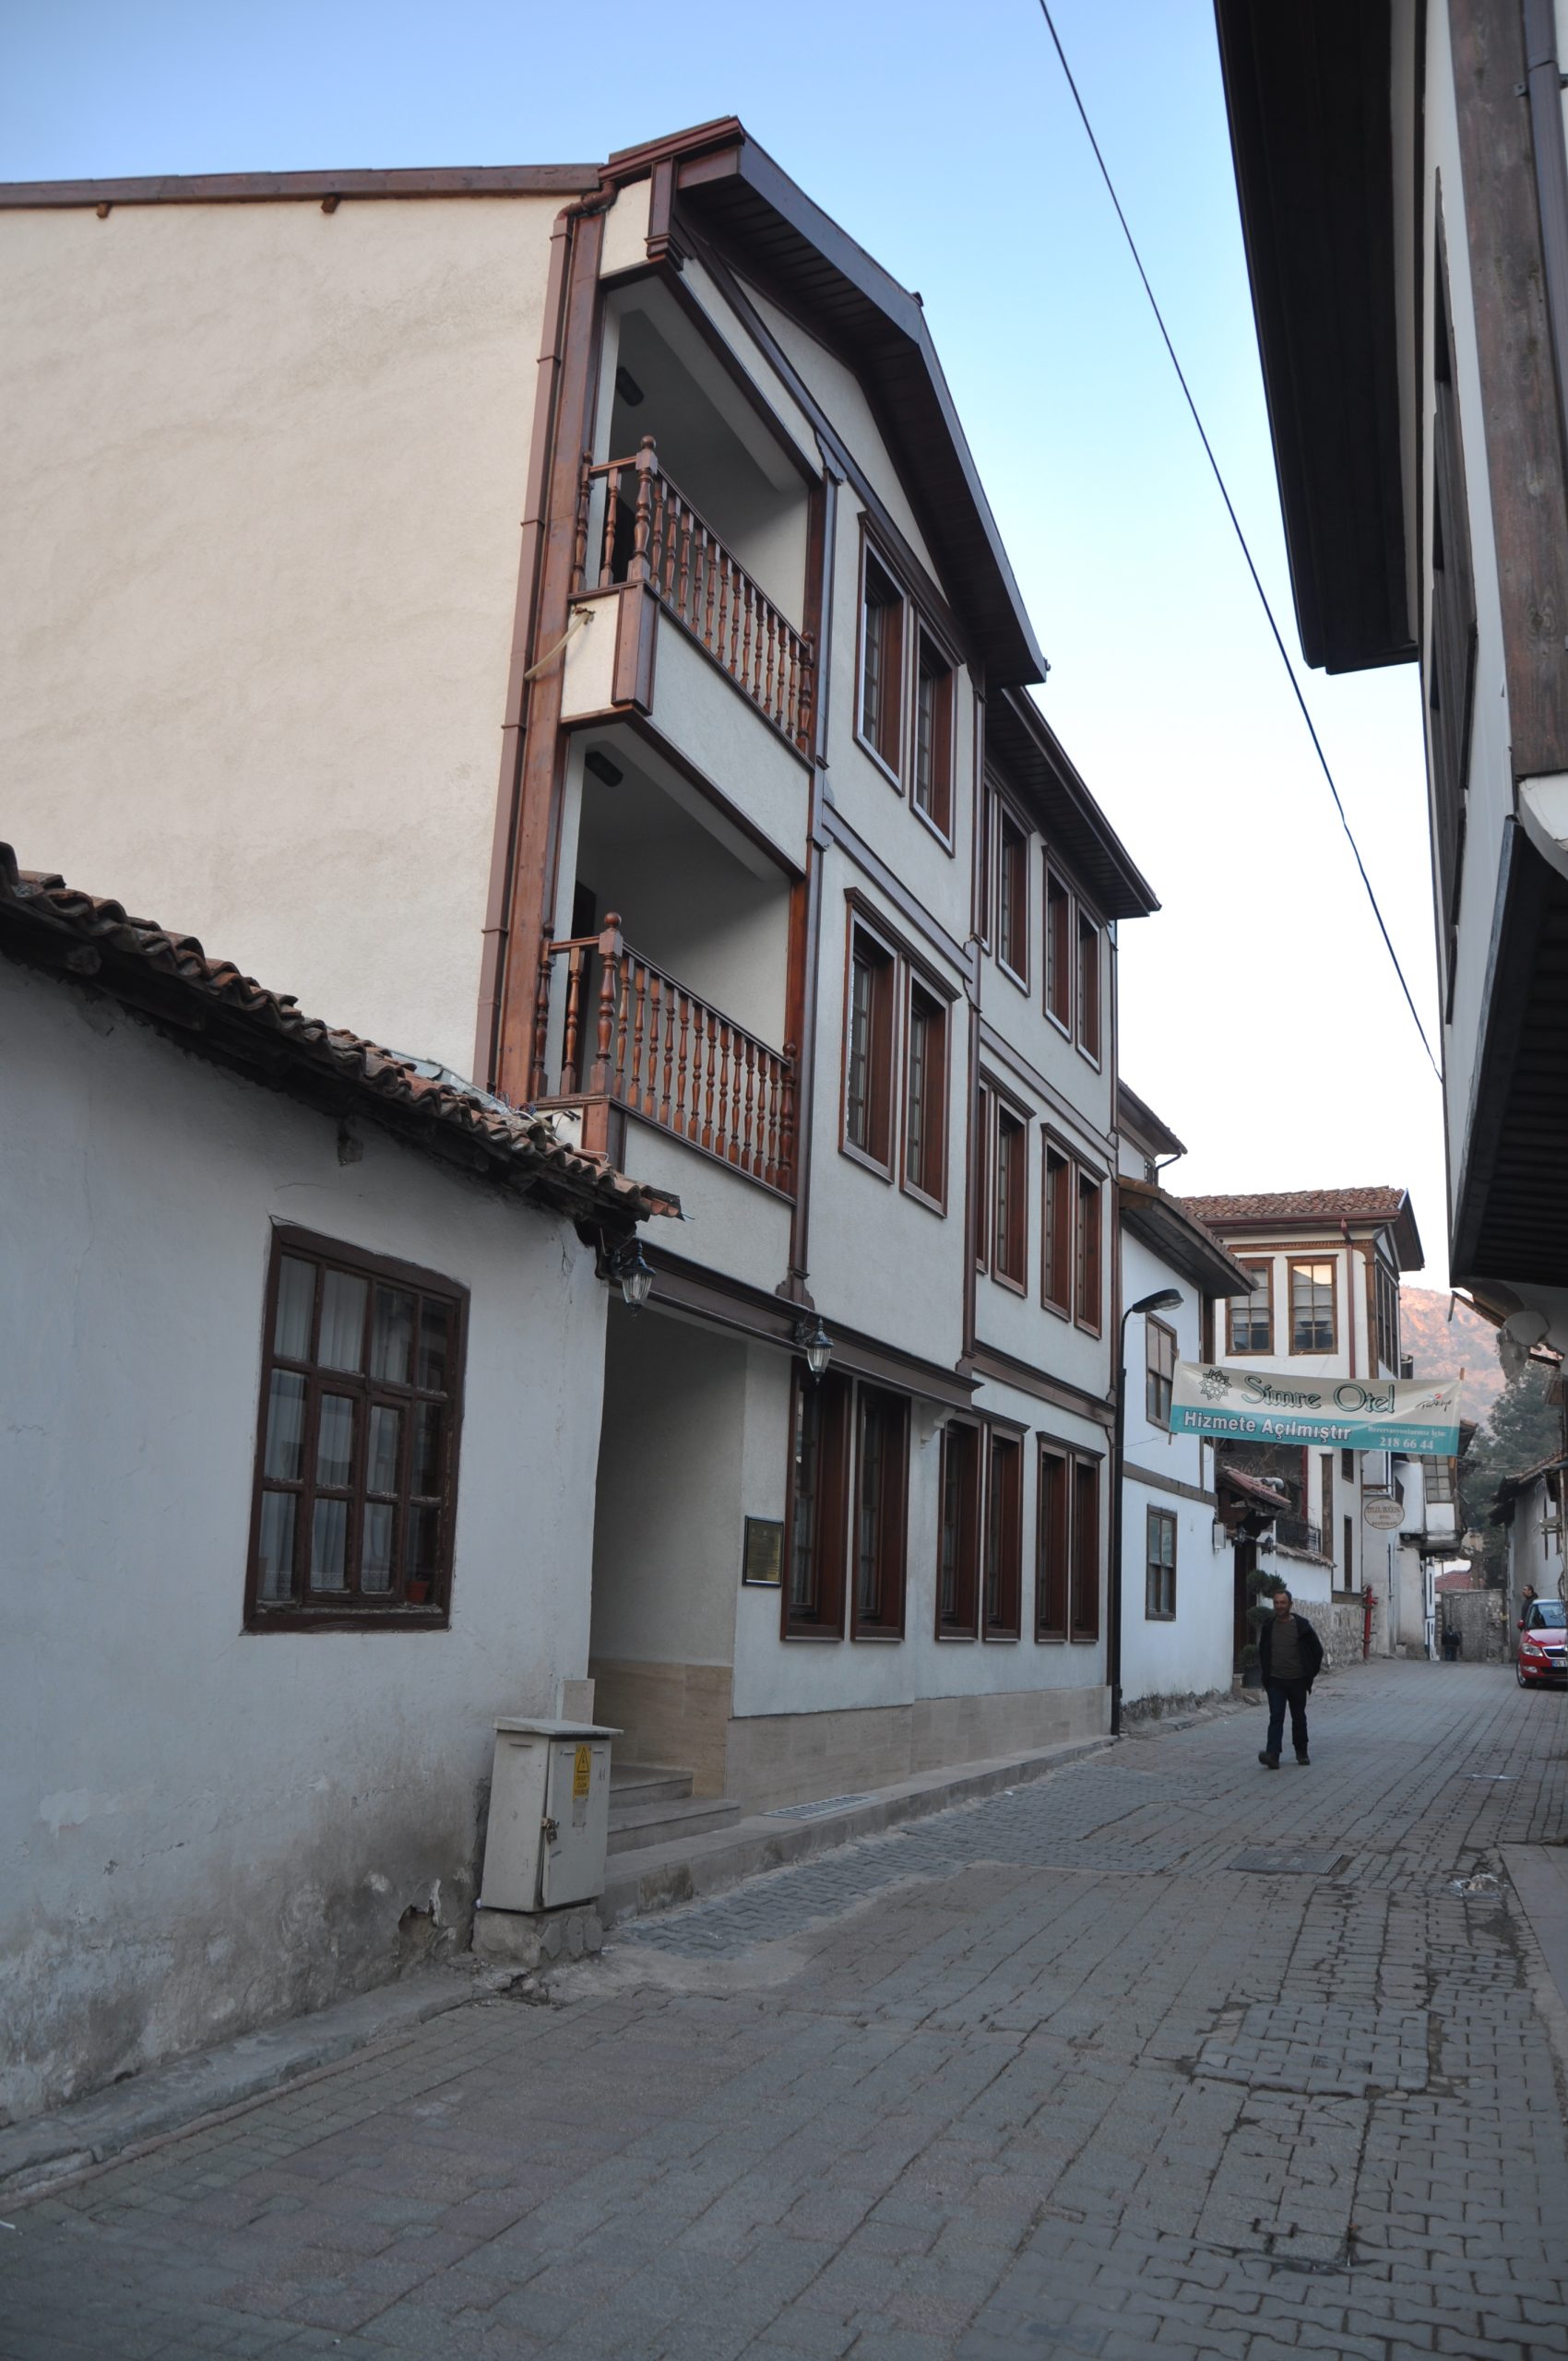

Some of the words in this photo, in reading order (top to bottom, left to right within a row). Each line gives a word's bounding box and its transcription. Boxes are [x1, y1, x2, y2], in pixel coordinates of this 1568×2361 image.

[1241, 1375, 1322, 1409] Simre
[1334, 1383, 1395, 1413] Otel
[1183, 1410, 1256, 1432] Hizmete
[1262, 1418, 1352, 1443] Açılmıştır
[1379, 1436, 1400, 1447] 218
[1403, 1438, 1417, 1449] 66
[1420, 1440, 1433, 1450] 44
